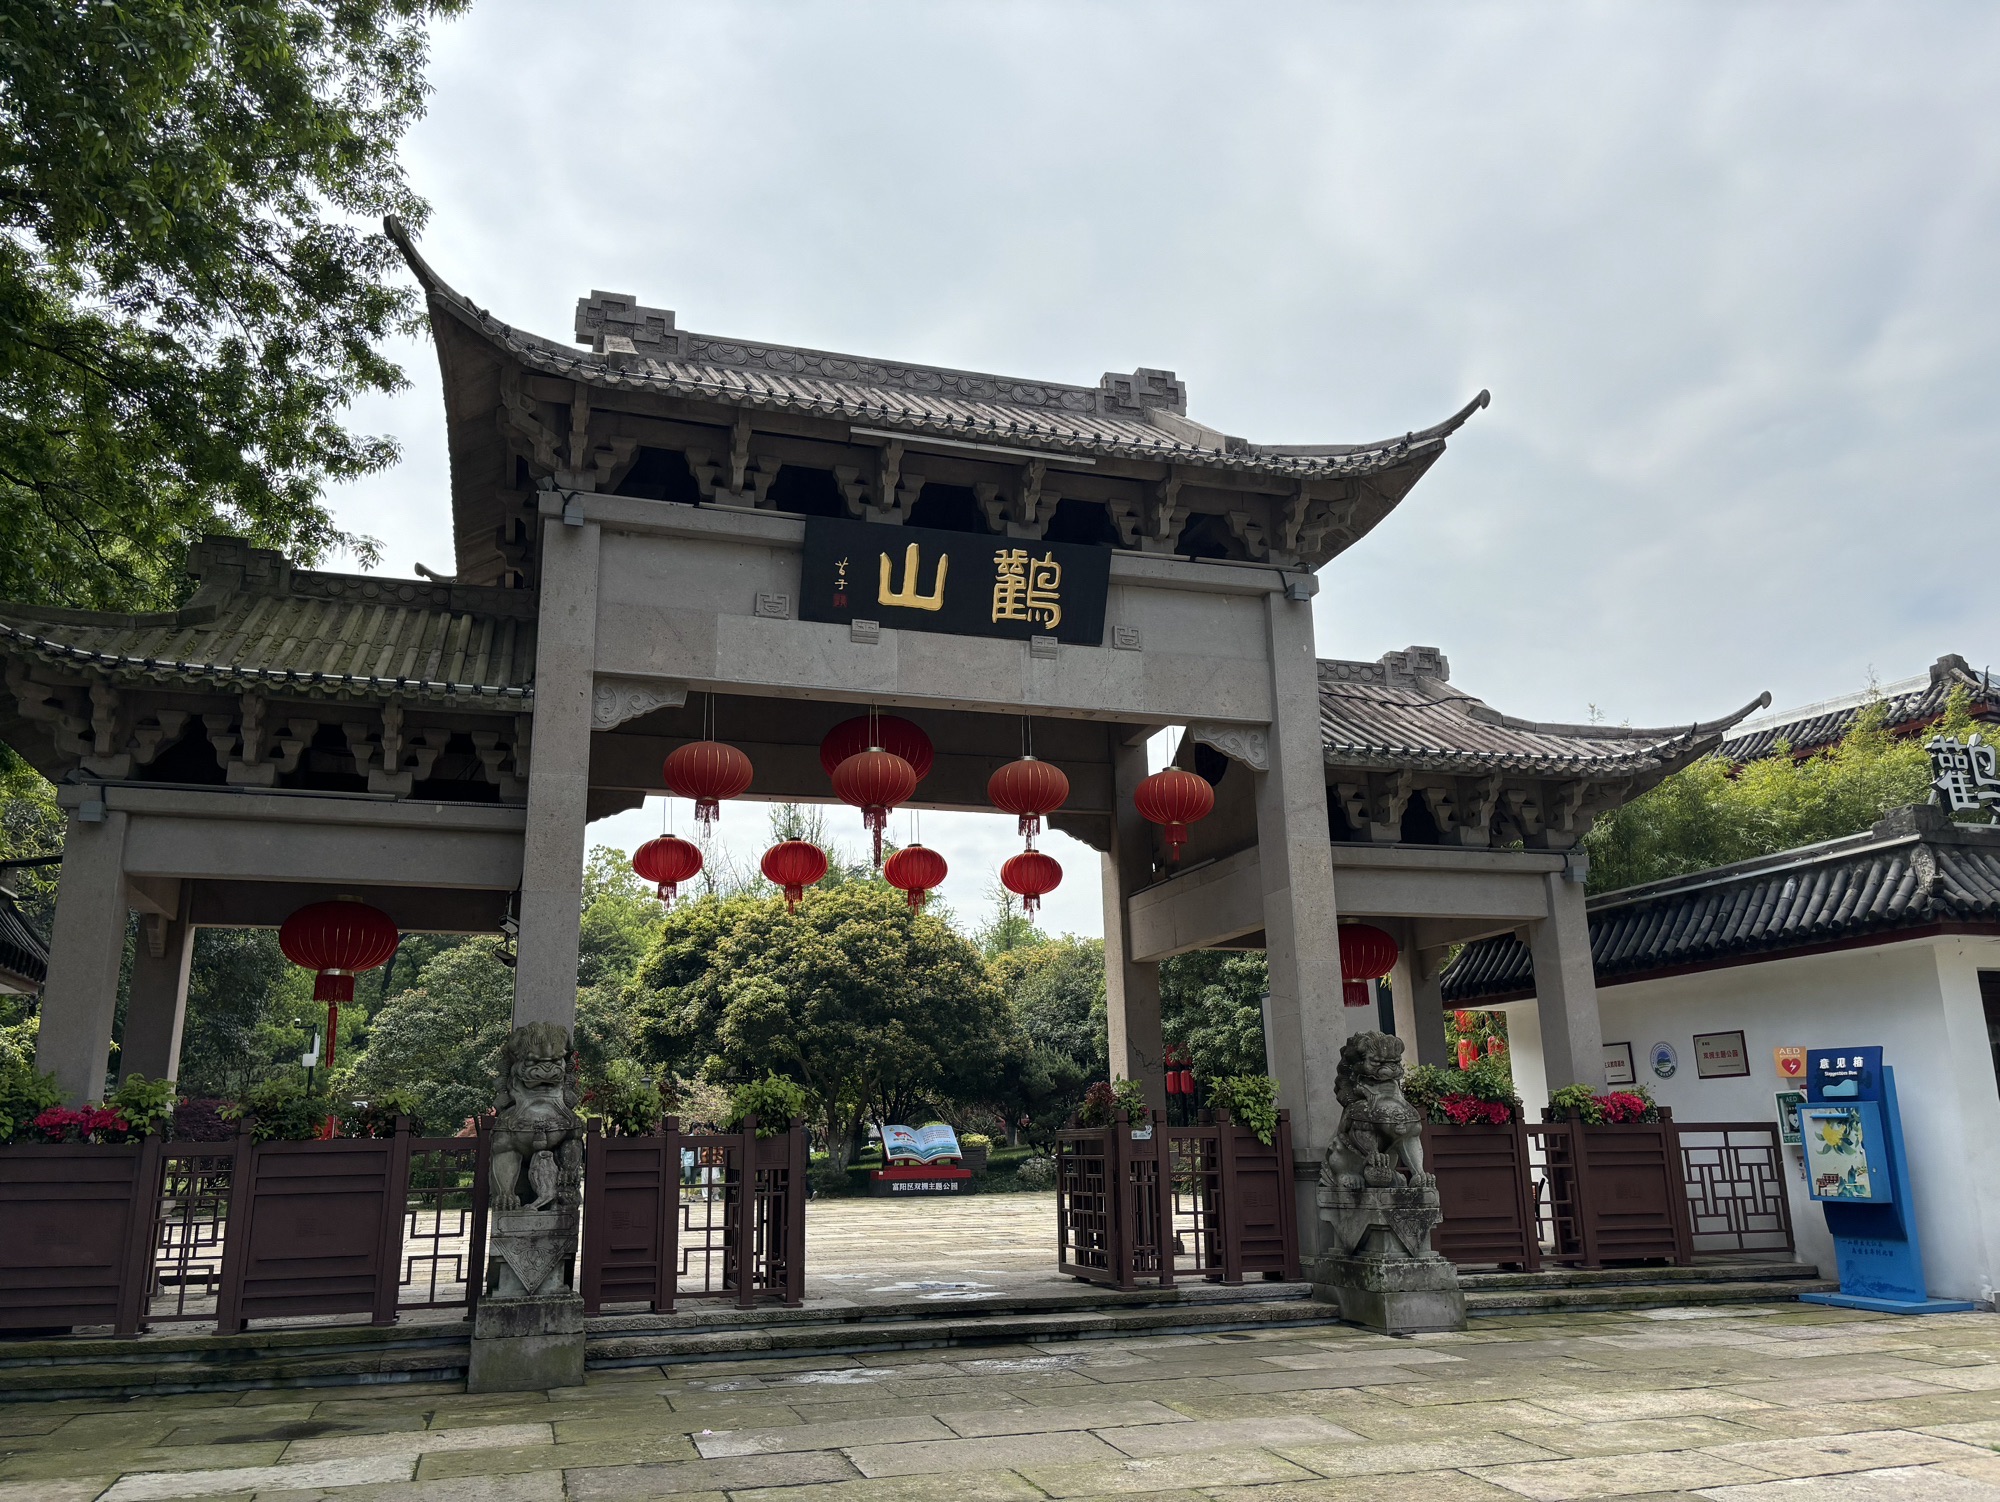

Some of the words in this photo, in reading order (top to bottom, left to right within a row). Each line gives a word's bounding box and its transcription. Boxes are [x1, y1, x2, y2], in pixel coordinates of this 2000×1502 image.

[1779, 1047, 1800, 1055] AED
[1819, 1056, 1864, 1069] 意见箱
[892, 1182, 959, 1192] 富阳区双拥主题公园
